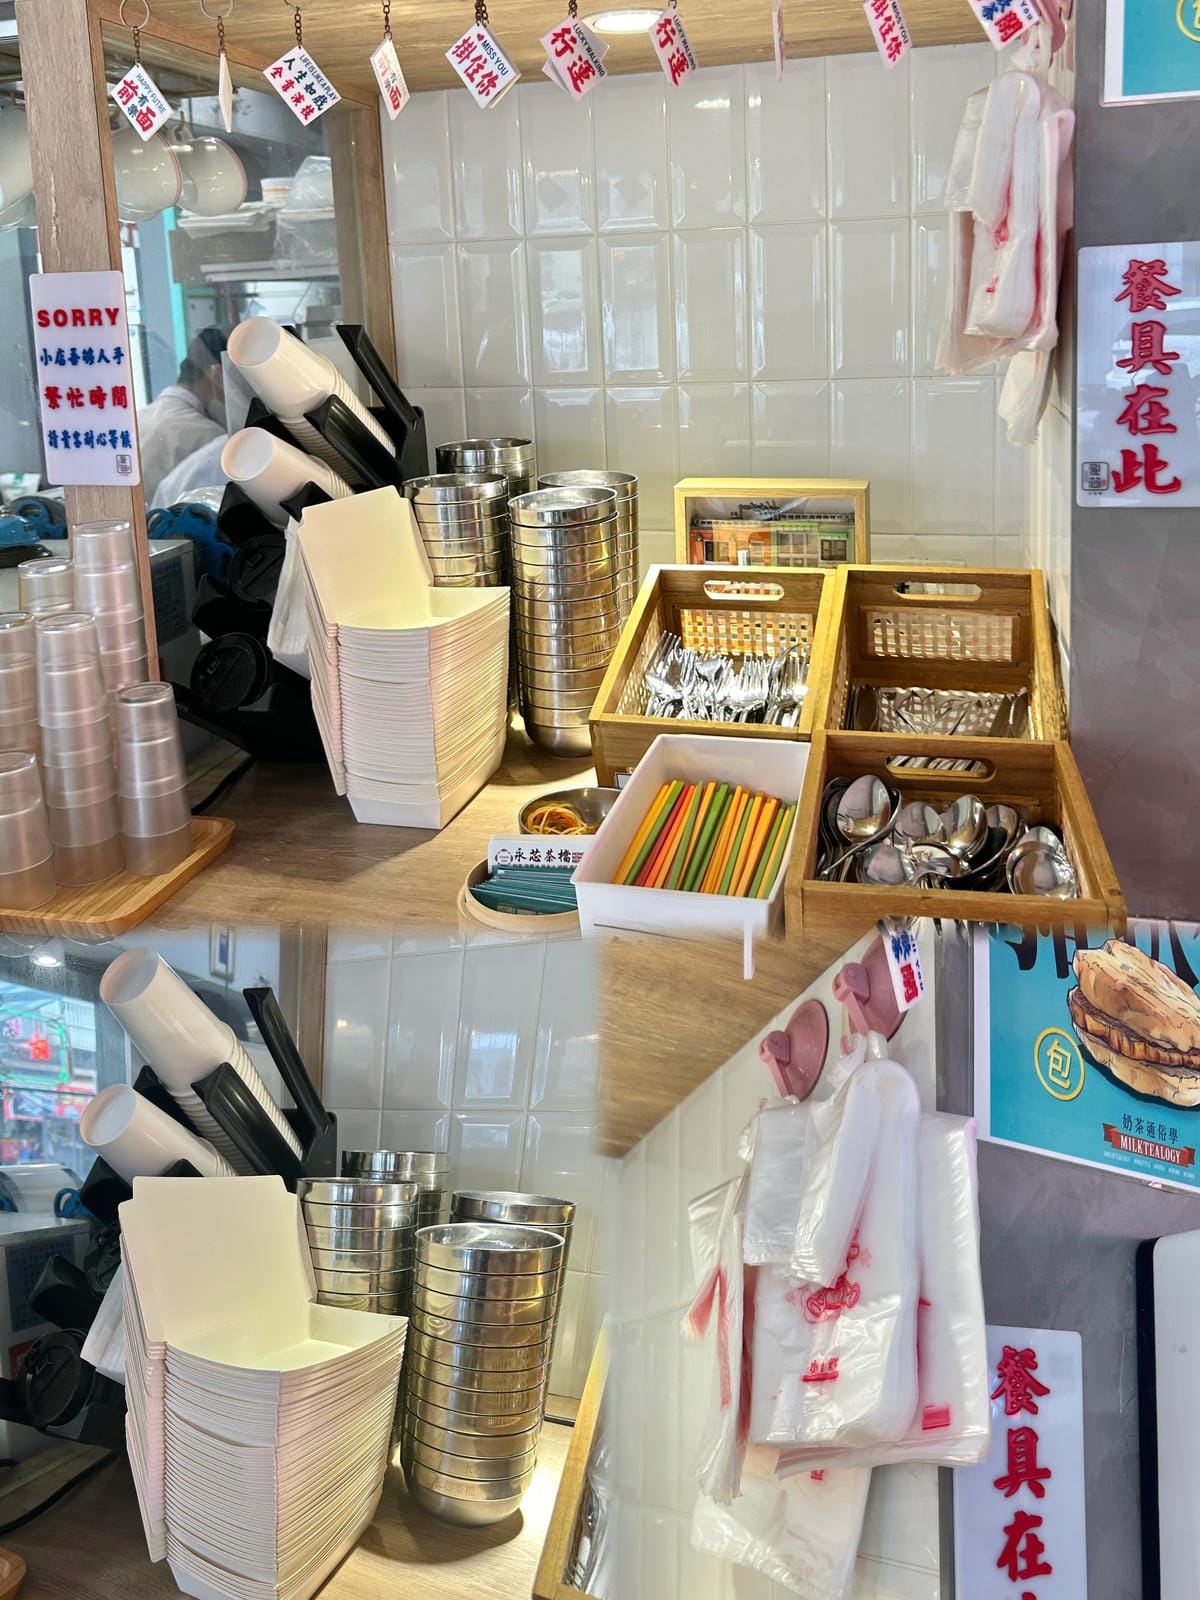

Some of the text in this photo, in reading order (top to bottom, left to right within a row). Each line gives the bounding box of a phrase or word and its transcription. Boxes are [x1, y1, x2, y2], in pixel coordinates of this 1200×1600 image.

[572, 23, 589, 47] LUCKY
[899, 22, 909, 44] YOU
[451, 34, 500, 97] 掛住你
[481, 38, 508, 76] MISS YOU
[550, 27, 597, 94] 行運
[656, 18, 689, 87] 行運
[136, 73, 153, 95] HAPPY
[270, 66, 315, 120] 全靠演技
[37, 308, 120, 328] SORRY
[1111, 259, 1182, 494] 餐具在此
[44, 385, 128, 410] 繁忙時間
[514, 847, 572, 863] 永芯茶檔
[1047, 1038, 1071, 1089] 包
[1122, 1113, 1178, 1144] 奶茶通俗學
[1120, 1135, 1183, 1164] MILKTEALOGY
[991, 1345, 1052, 1600] 餐具在
